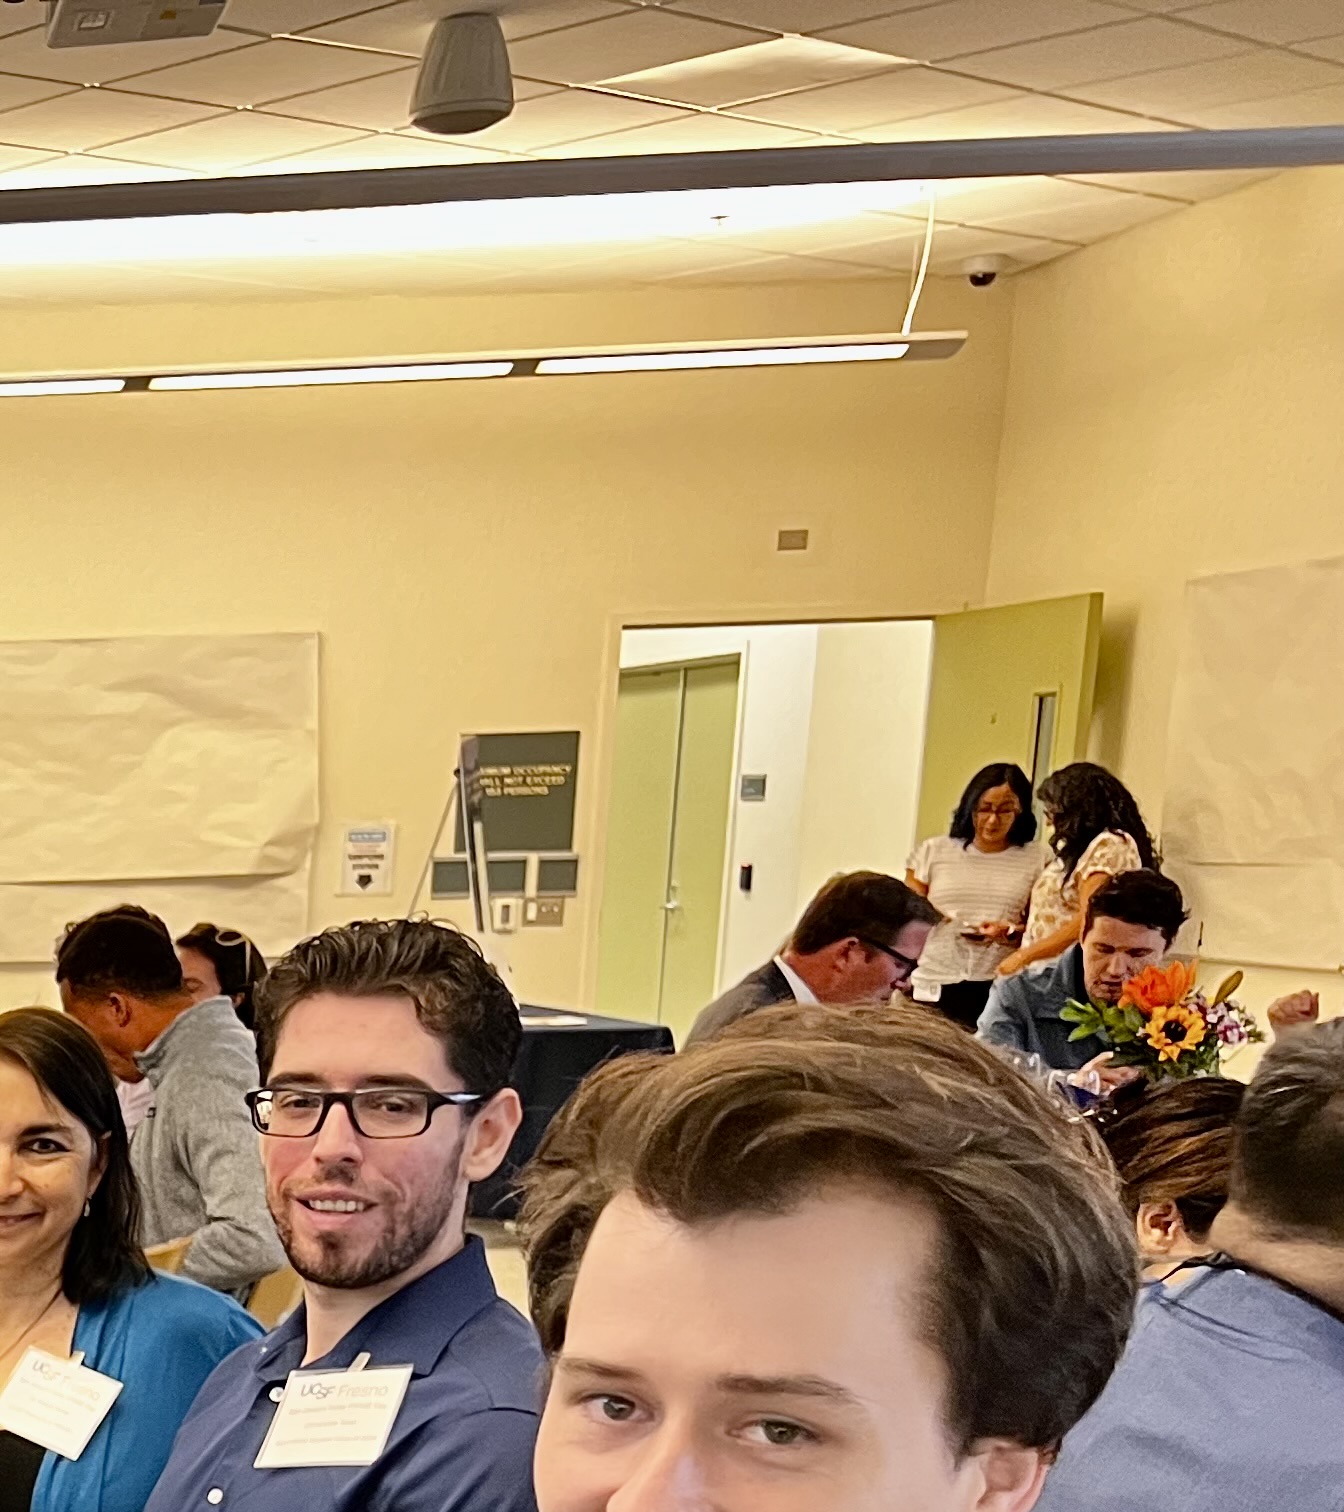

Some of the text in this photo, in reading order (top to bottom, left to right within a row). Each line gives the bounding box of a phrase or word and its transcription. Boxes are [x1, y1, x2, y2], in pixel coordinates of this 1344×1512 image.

[525, 775, 566, 786] EXCEED
[300, 1382, 389, 1400] UCSF Fresno
